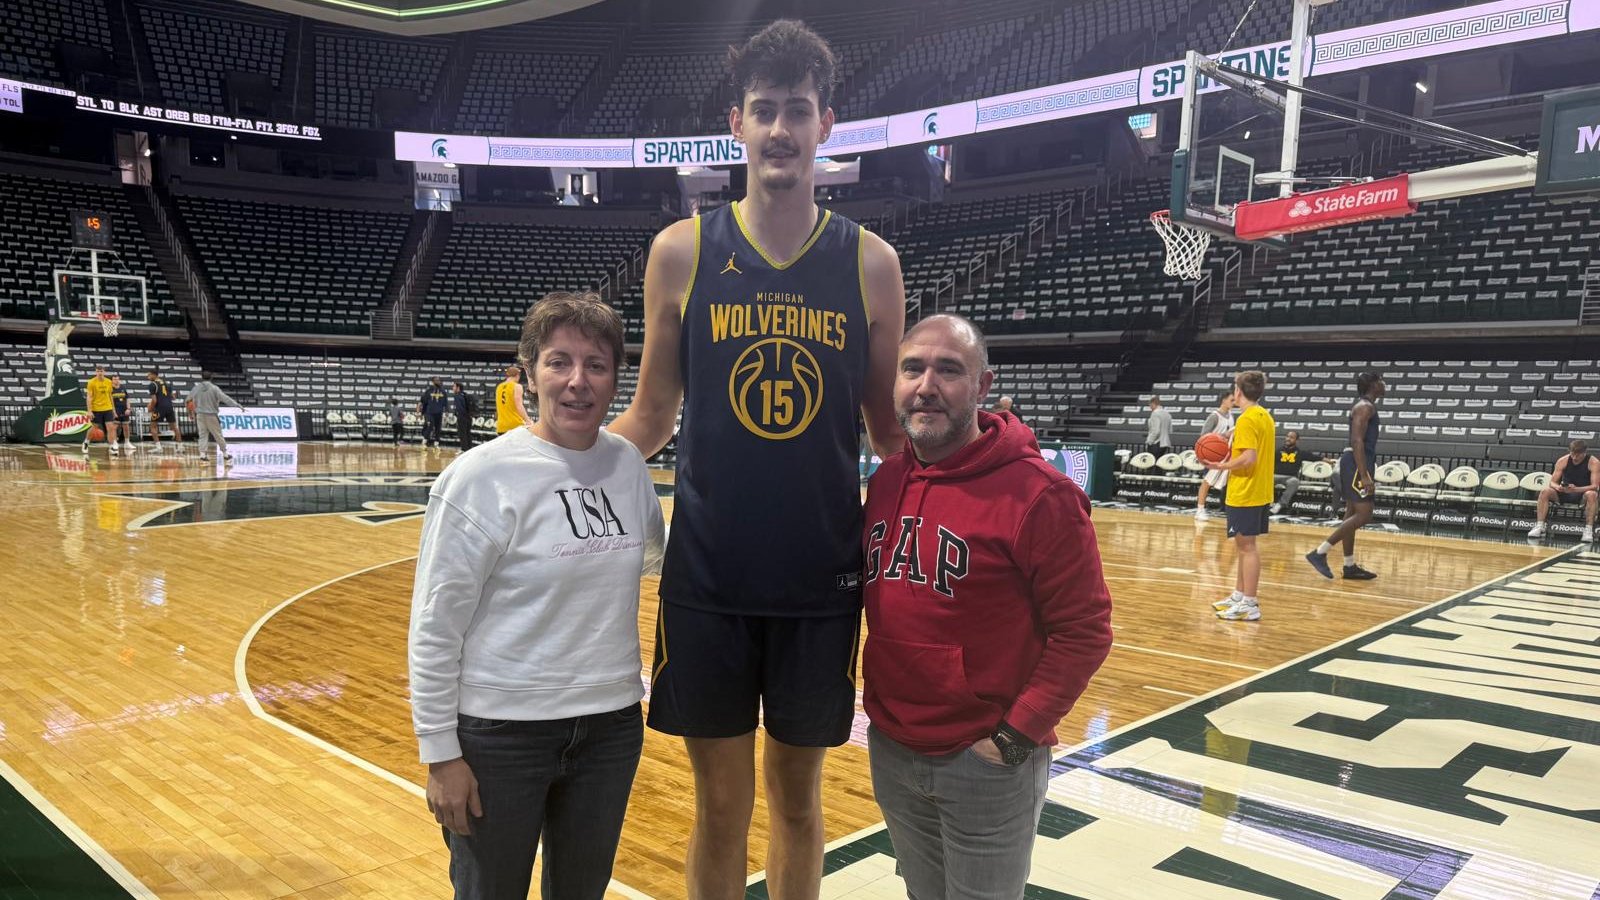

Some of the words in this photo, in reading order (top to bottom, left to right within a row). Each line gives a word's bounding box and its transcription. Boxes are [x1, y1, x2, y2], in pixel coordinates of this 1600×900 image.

[2, 84, 19, 93] FLS
[77, 95, 97, 108] STL
[101, 99, 114, 111] TO
[119, 102, 139, 114] BLK
[143, 106, 163, 117] AST
[165, 109, 190, 121] OREB
[193, 113, 211, 124] REB
[212, 115, 253, 130] FTM-FTA
[256, 121, 273, 133] FT%
[276, 123, 299, 135] 3FG%
[302, 126, 320, 137] FG%
[644, 139, 743, 163] SPARTANS
[756, 291, 804, 304] MICHIGAN
[710, 303, 847, 352] WOLVERINES
[760, 379, 794, 426] 15
[44, 415, 91, 437] LIBMAN
[219, 415, 292, 430] SPARTANS
[1280, 453, 1296, 463] M
[1299, 502, 1321, 510] Rocket
[554, 487, 629, 540] USA
[1402, 510, 1428, 519] Rocket
[1440, 514, 1466, 522] Rocket
[1479, 516, 1506, 525] Rocket
[1519, 520, 1547, 529] Roct
[1559, 524, 1587, 533] Rocke
[866, 516, 969, 598] GAP
